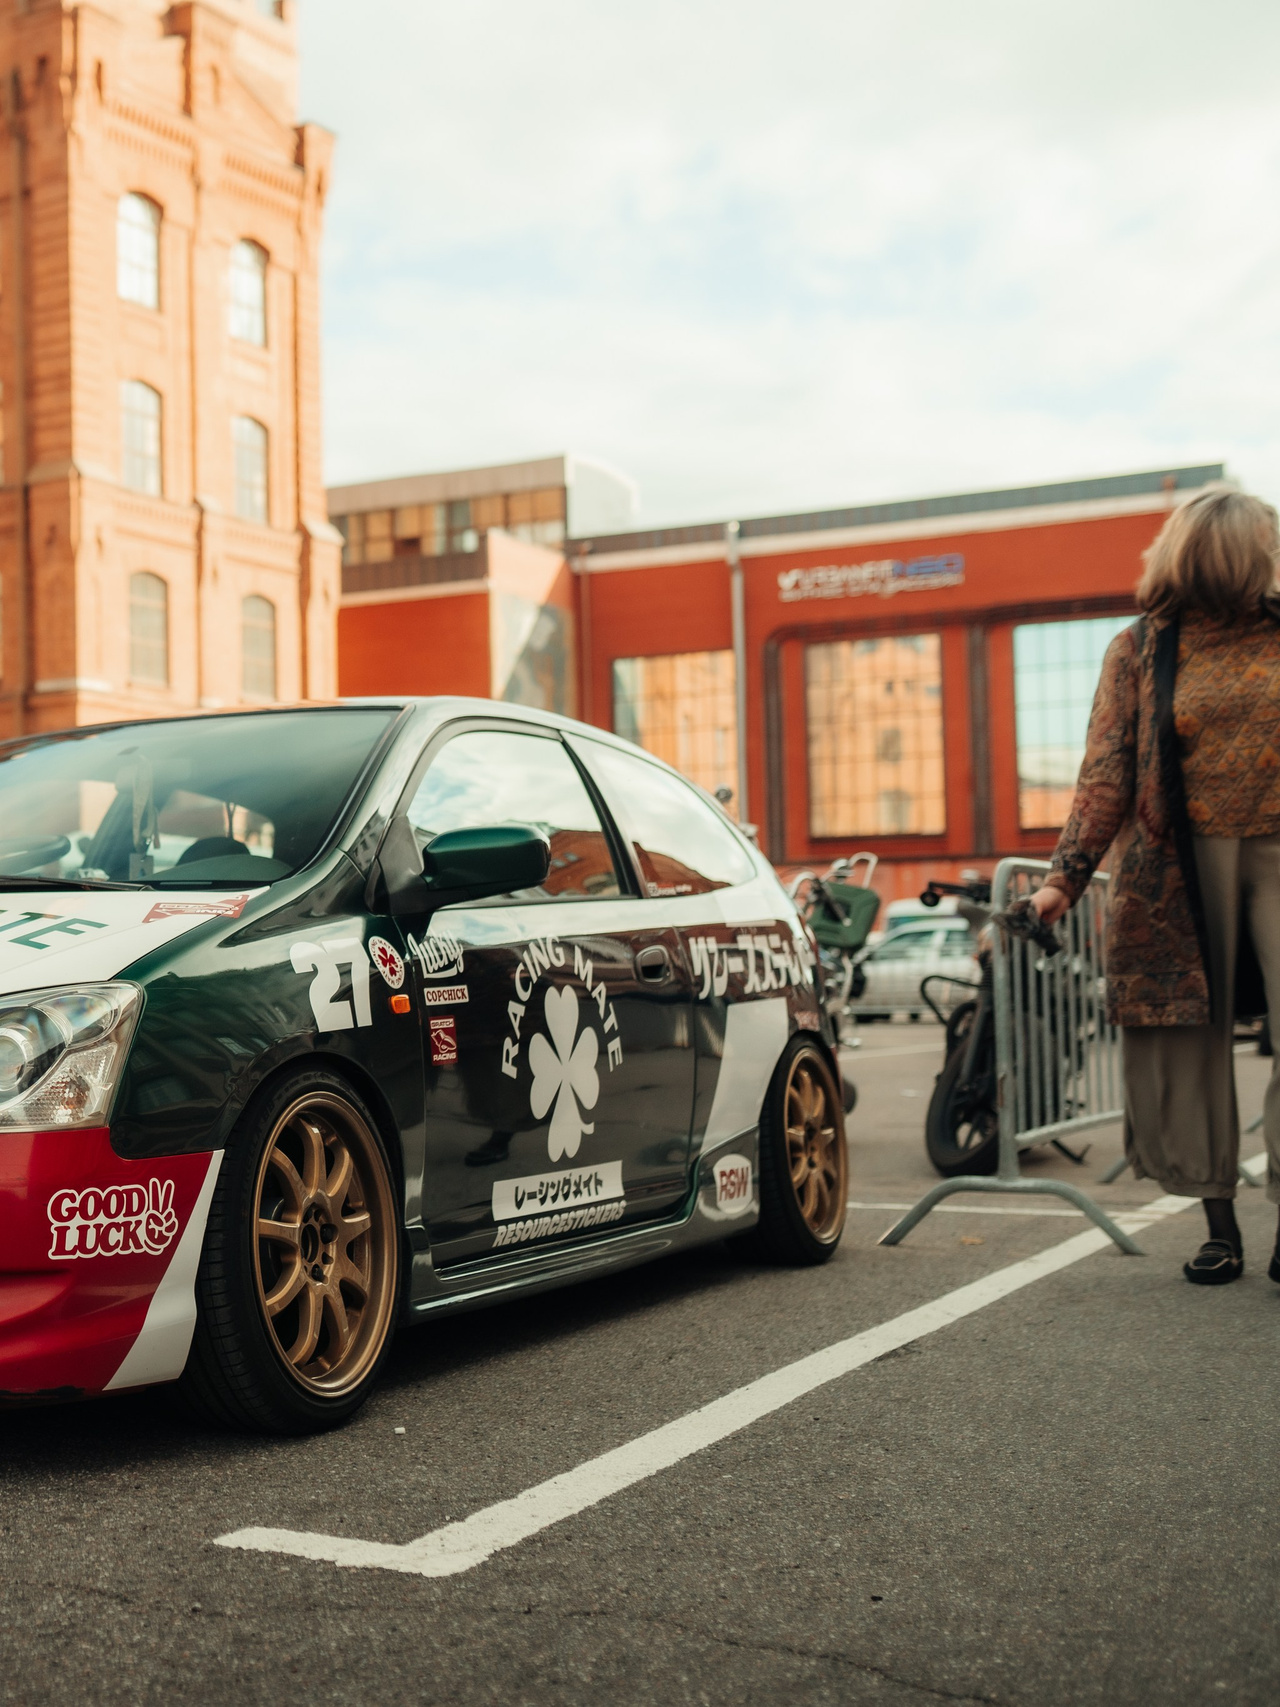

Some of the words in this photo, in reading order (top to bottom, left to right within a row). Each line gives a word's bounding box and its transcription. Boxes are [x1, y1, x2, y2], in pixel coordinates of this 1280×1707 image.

[289, 937, 373, 1033] 27
[426, 987, 468, 1003] COPCHICK
[502, 934, 565, 1080] RACING
[574, 945, 623, 1073] MATE
[433, 1052, 456, 1062] RACING
[514, 1171, 603, 1210] レーシングメイト
[718, 1166, 749, 1202] RSW
[48, 1185, 148, 1223] GOOD
[49, 1220, 145, 1259] LUCK
[492, 1200, 627, 1248] RESOURCESTICKERS
